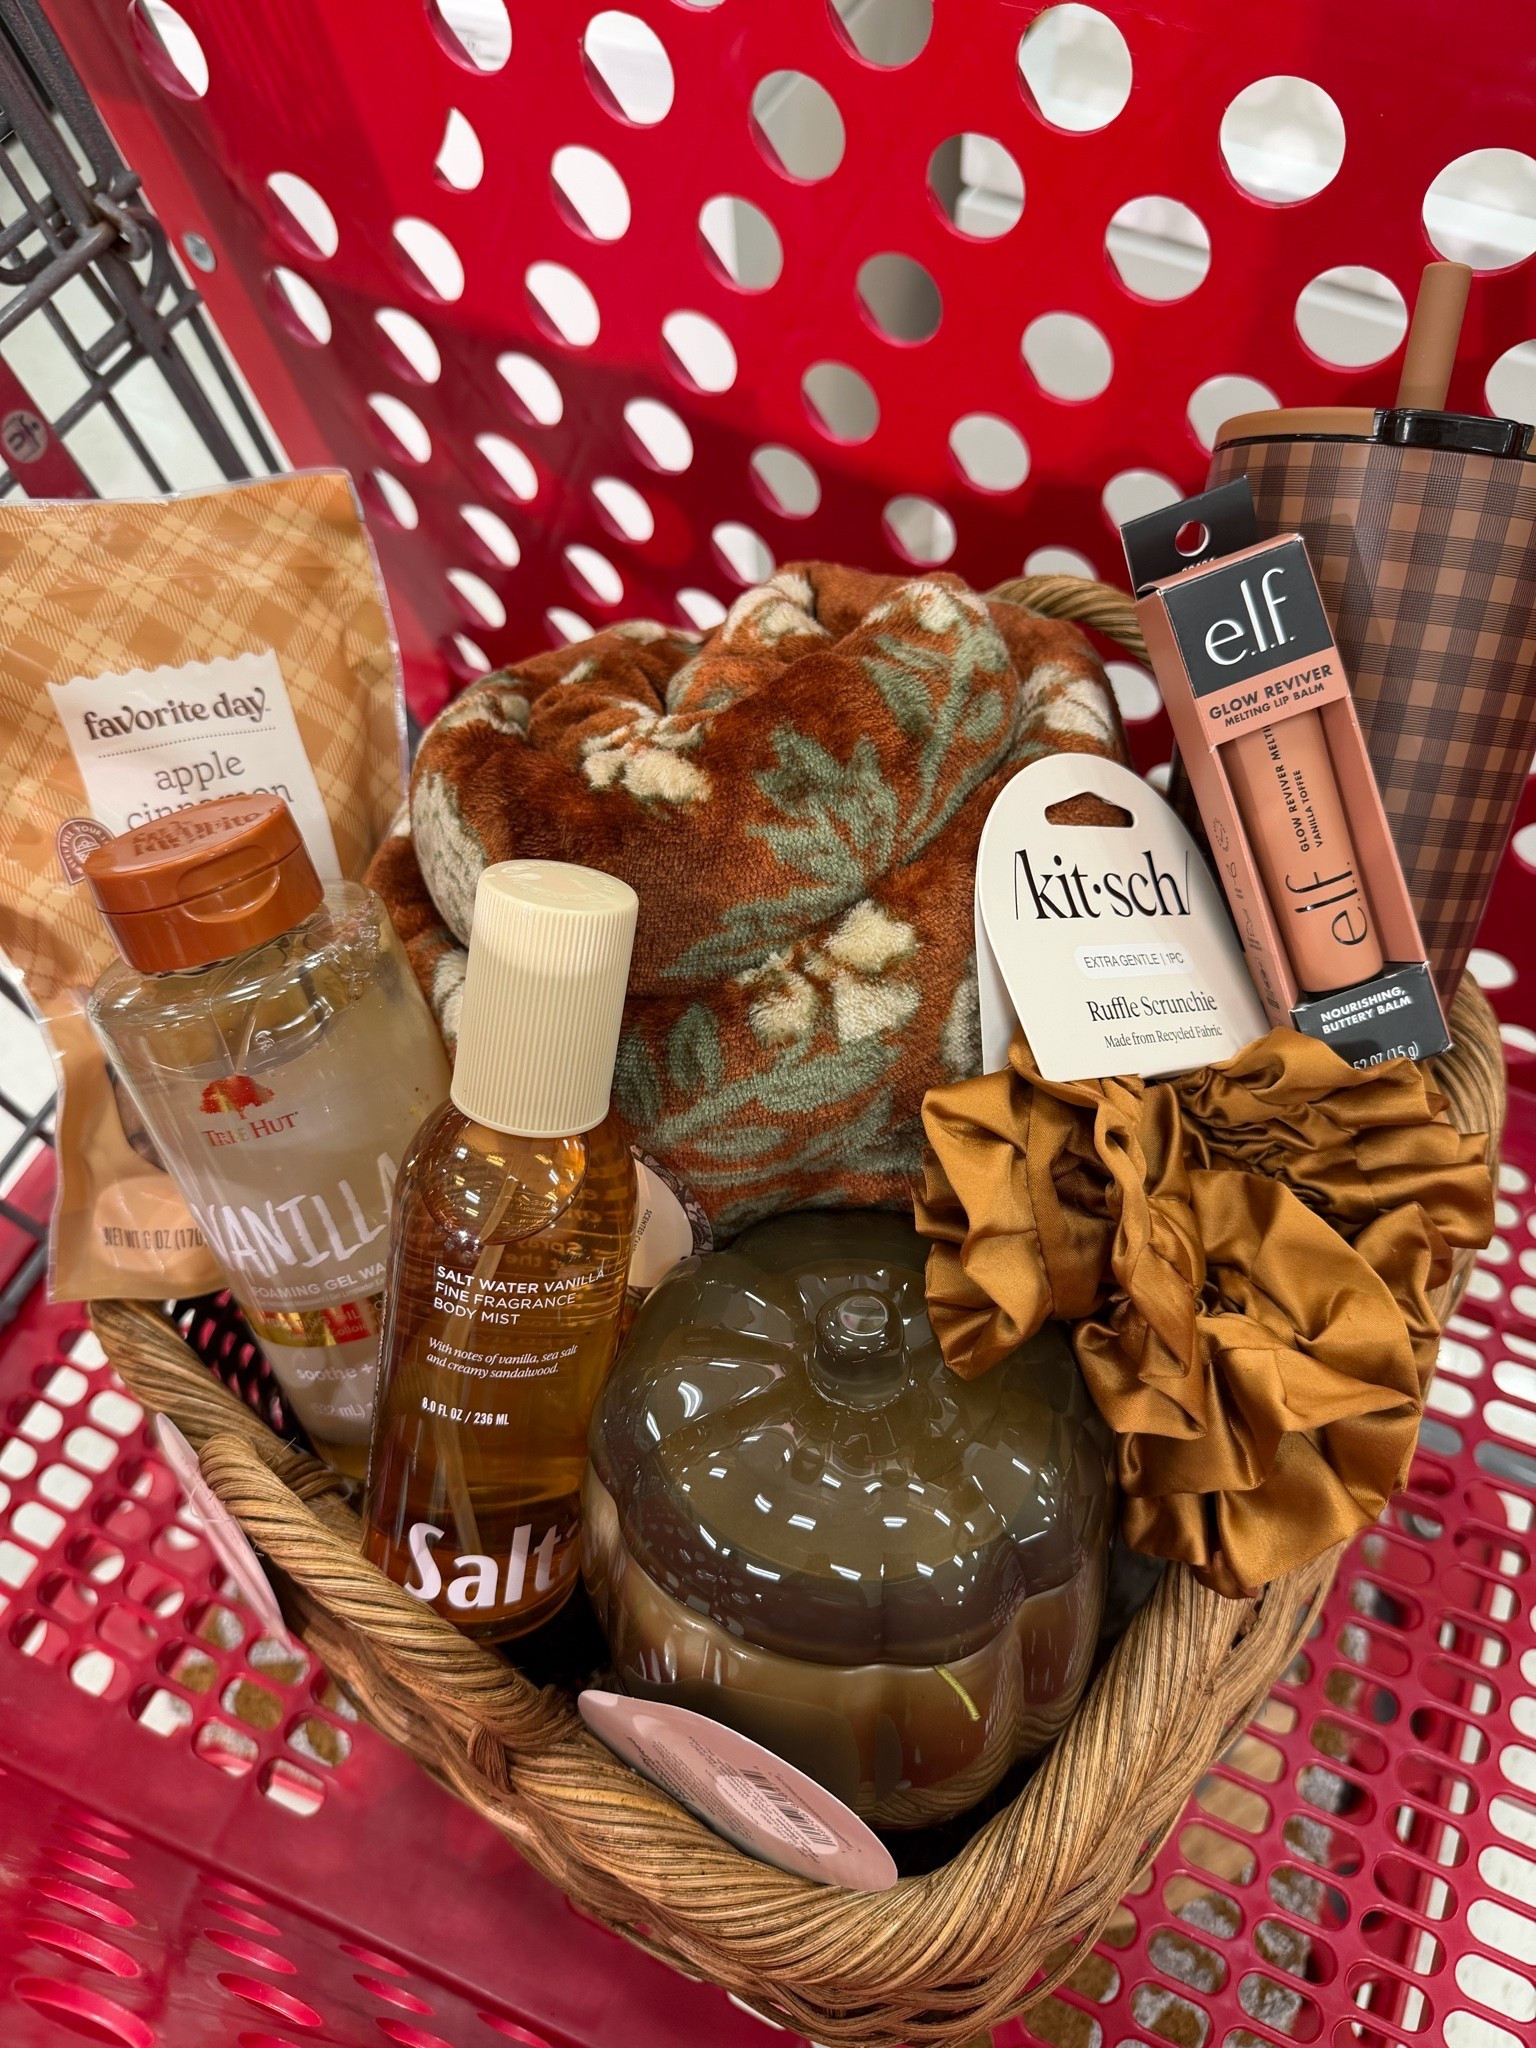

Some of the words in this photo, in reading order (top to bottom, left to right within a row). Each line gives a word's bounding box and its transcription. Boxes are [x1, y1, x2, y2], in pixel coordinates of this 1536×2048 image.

[1208, 690, 1258, 720] GLOW
[1263, 664, 1333, 699] REVIVER
[1224, 702, 1271, 728] MELTING
[1274, 695, 1290, 708] LIP
[1293, 682, 1325, 701] BALM
[84, 699, 210, 741] favorite
[212, 687, 267, 723] day
[154, 750, 245, 795] apple
[1292, 769, 1310, 804] TOFFEE
[1275, 764, 1298, 813] REVIVER
[1291, 817, 1310, 852] GLOW
[1304, 805, 1323, 848] VANILLA
[1084, 955, 1120, 969] EXTRA
[1120, 953, 1160, 967] GENTLE
[1166, 952, 1185, 965] 1PC
[1086, 995, 1140, 1022] Ruffle
[1140, 991, 1218, 1017] Scrunchie
[1320, 986, 1407, 1022] NOURISHING,
[1322, 1008, 1374, 1035] BUTTERY
[1376, 995, 1412, 1015] BALM
[1104, 1034, 1132, 1049] Made
[1131, 1031, 1156, 1046] from
[1155, 1025, 1196, 1044] Recycled
[1195, 1024, 1223, 1039] Fabric
[249, 1113, 296, 1139] HUT
[104, 1227, 123, 1247] NET
[123, 1230, 140, 1249] WT
[155, 1230, 171, 1249] OZ
[252, 1284, 320, 1298] FOAMING
[324, 1274, 358, 1291] GEL
[358, 1262, 386, 1280] WA
[437, 1265, 475, 1287] SALT
[478, 1278, 539, 1294] WATER
[544, 1268, 605, 1293] VANILLA
[433, 1296, 478, 1320] BODY
[481, 1311, 521, 1325] MIST
[435, 1281, 470, 1303] FINE
[473, 1292, 577, 1310] FRAGRANCE
[426, 1352, 447, 1368] and
[447, 1361, 489, 1379] creamy
[489, 1362, 559, 1379] sandalwood.
[429, 1336, 453, 1355] With
[453, 1347, 484, 1363] notes
[484, 1353, 500, 1366] of
[498, 1351, 540, 1365] vanilla,
[541, 1351, 558, 1363] sea
[560, 1344, 578, 1358] salt
[296, 1366, 358, 1381] soothe
[421, 1396, 437, 1413] 8.0
[437, 1403, 448, 1417] FL
[450, 1407, 464, 1421] OZ
[472, 1411, 494, 1425] 236
[495, 1413, 510, 1426] ML
